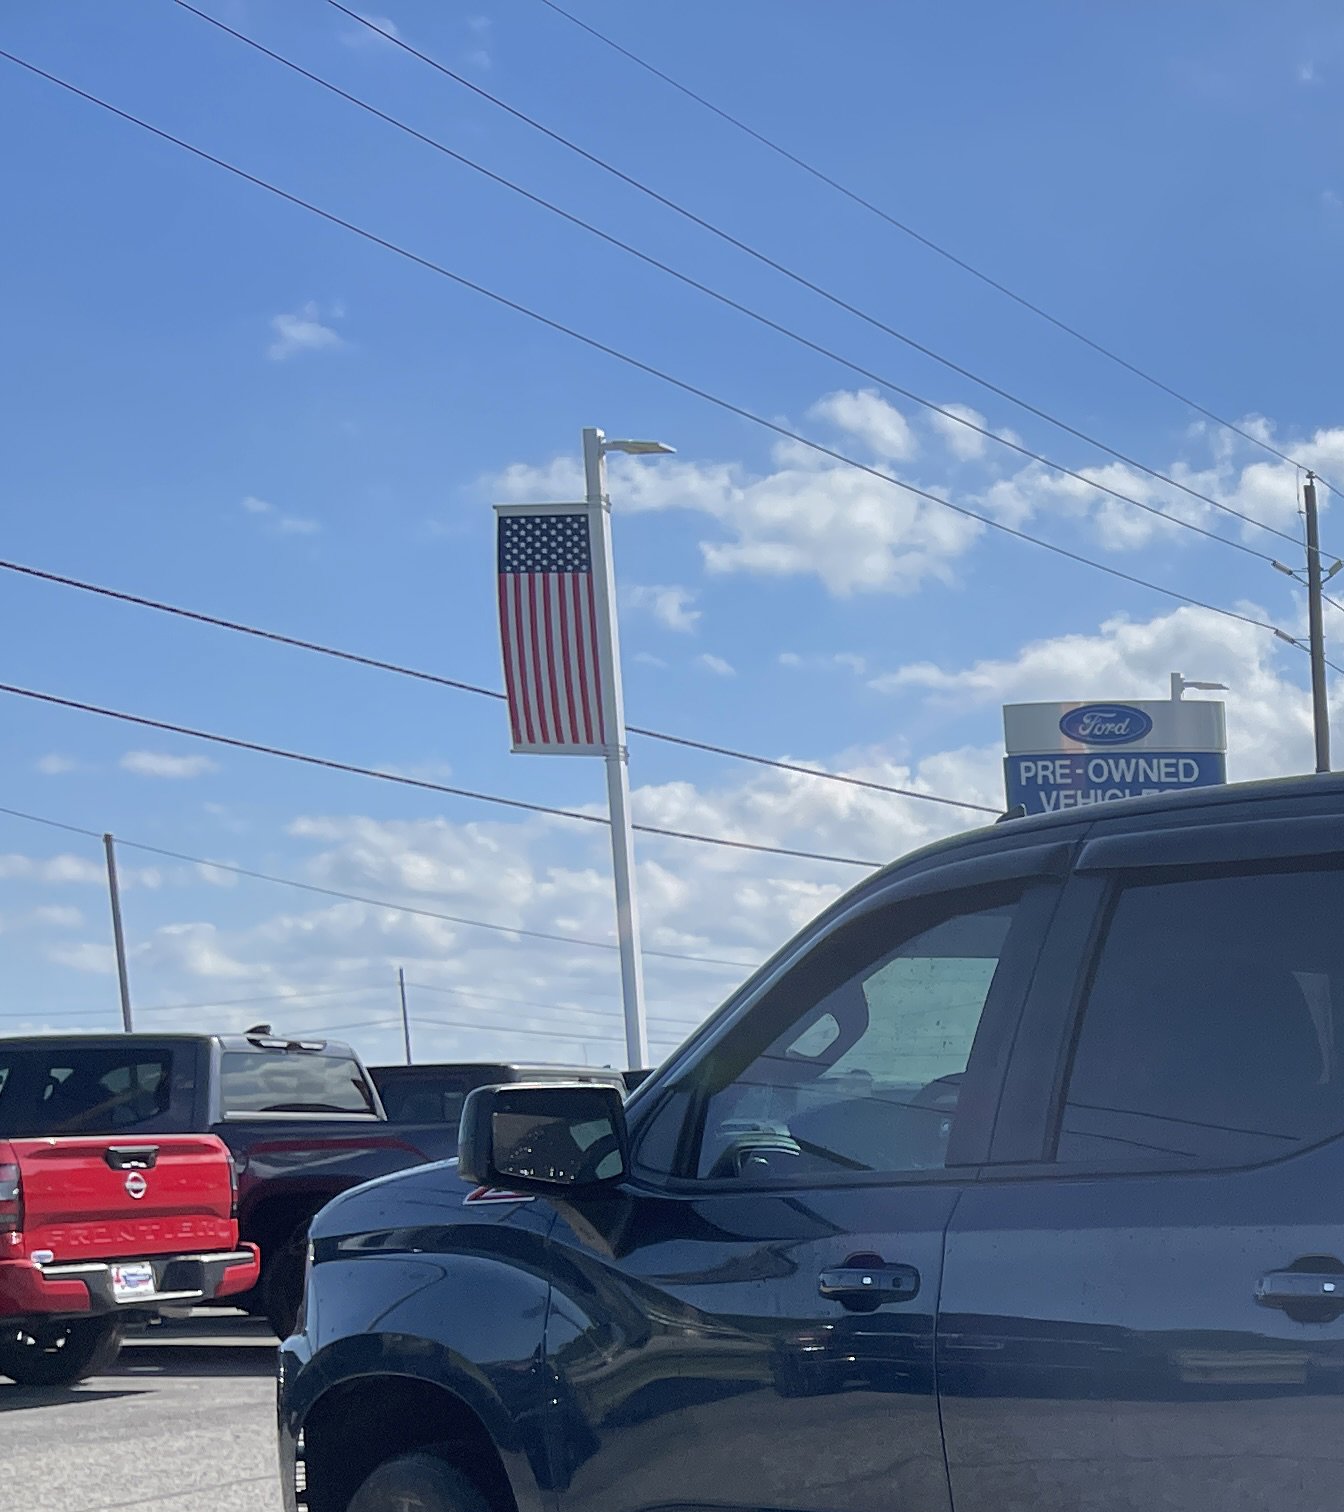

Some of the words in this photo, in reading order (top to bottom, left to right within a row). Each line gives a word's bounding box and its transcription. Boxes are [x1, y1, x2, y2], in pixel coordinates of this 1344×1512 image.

[1078, 712, 1131, 735] Ford
[1019, 757, 1200, 786] PRE-OWNED
[1039, 788, 1181, 813] VEHIC
